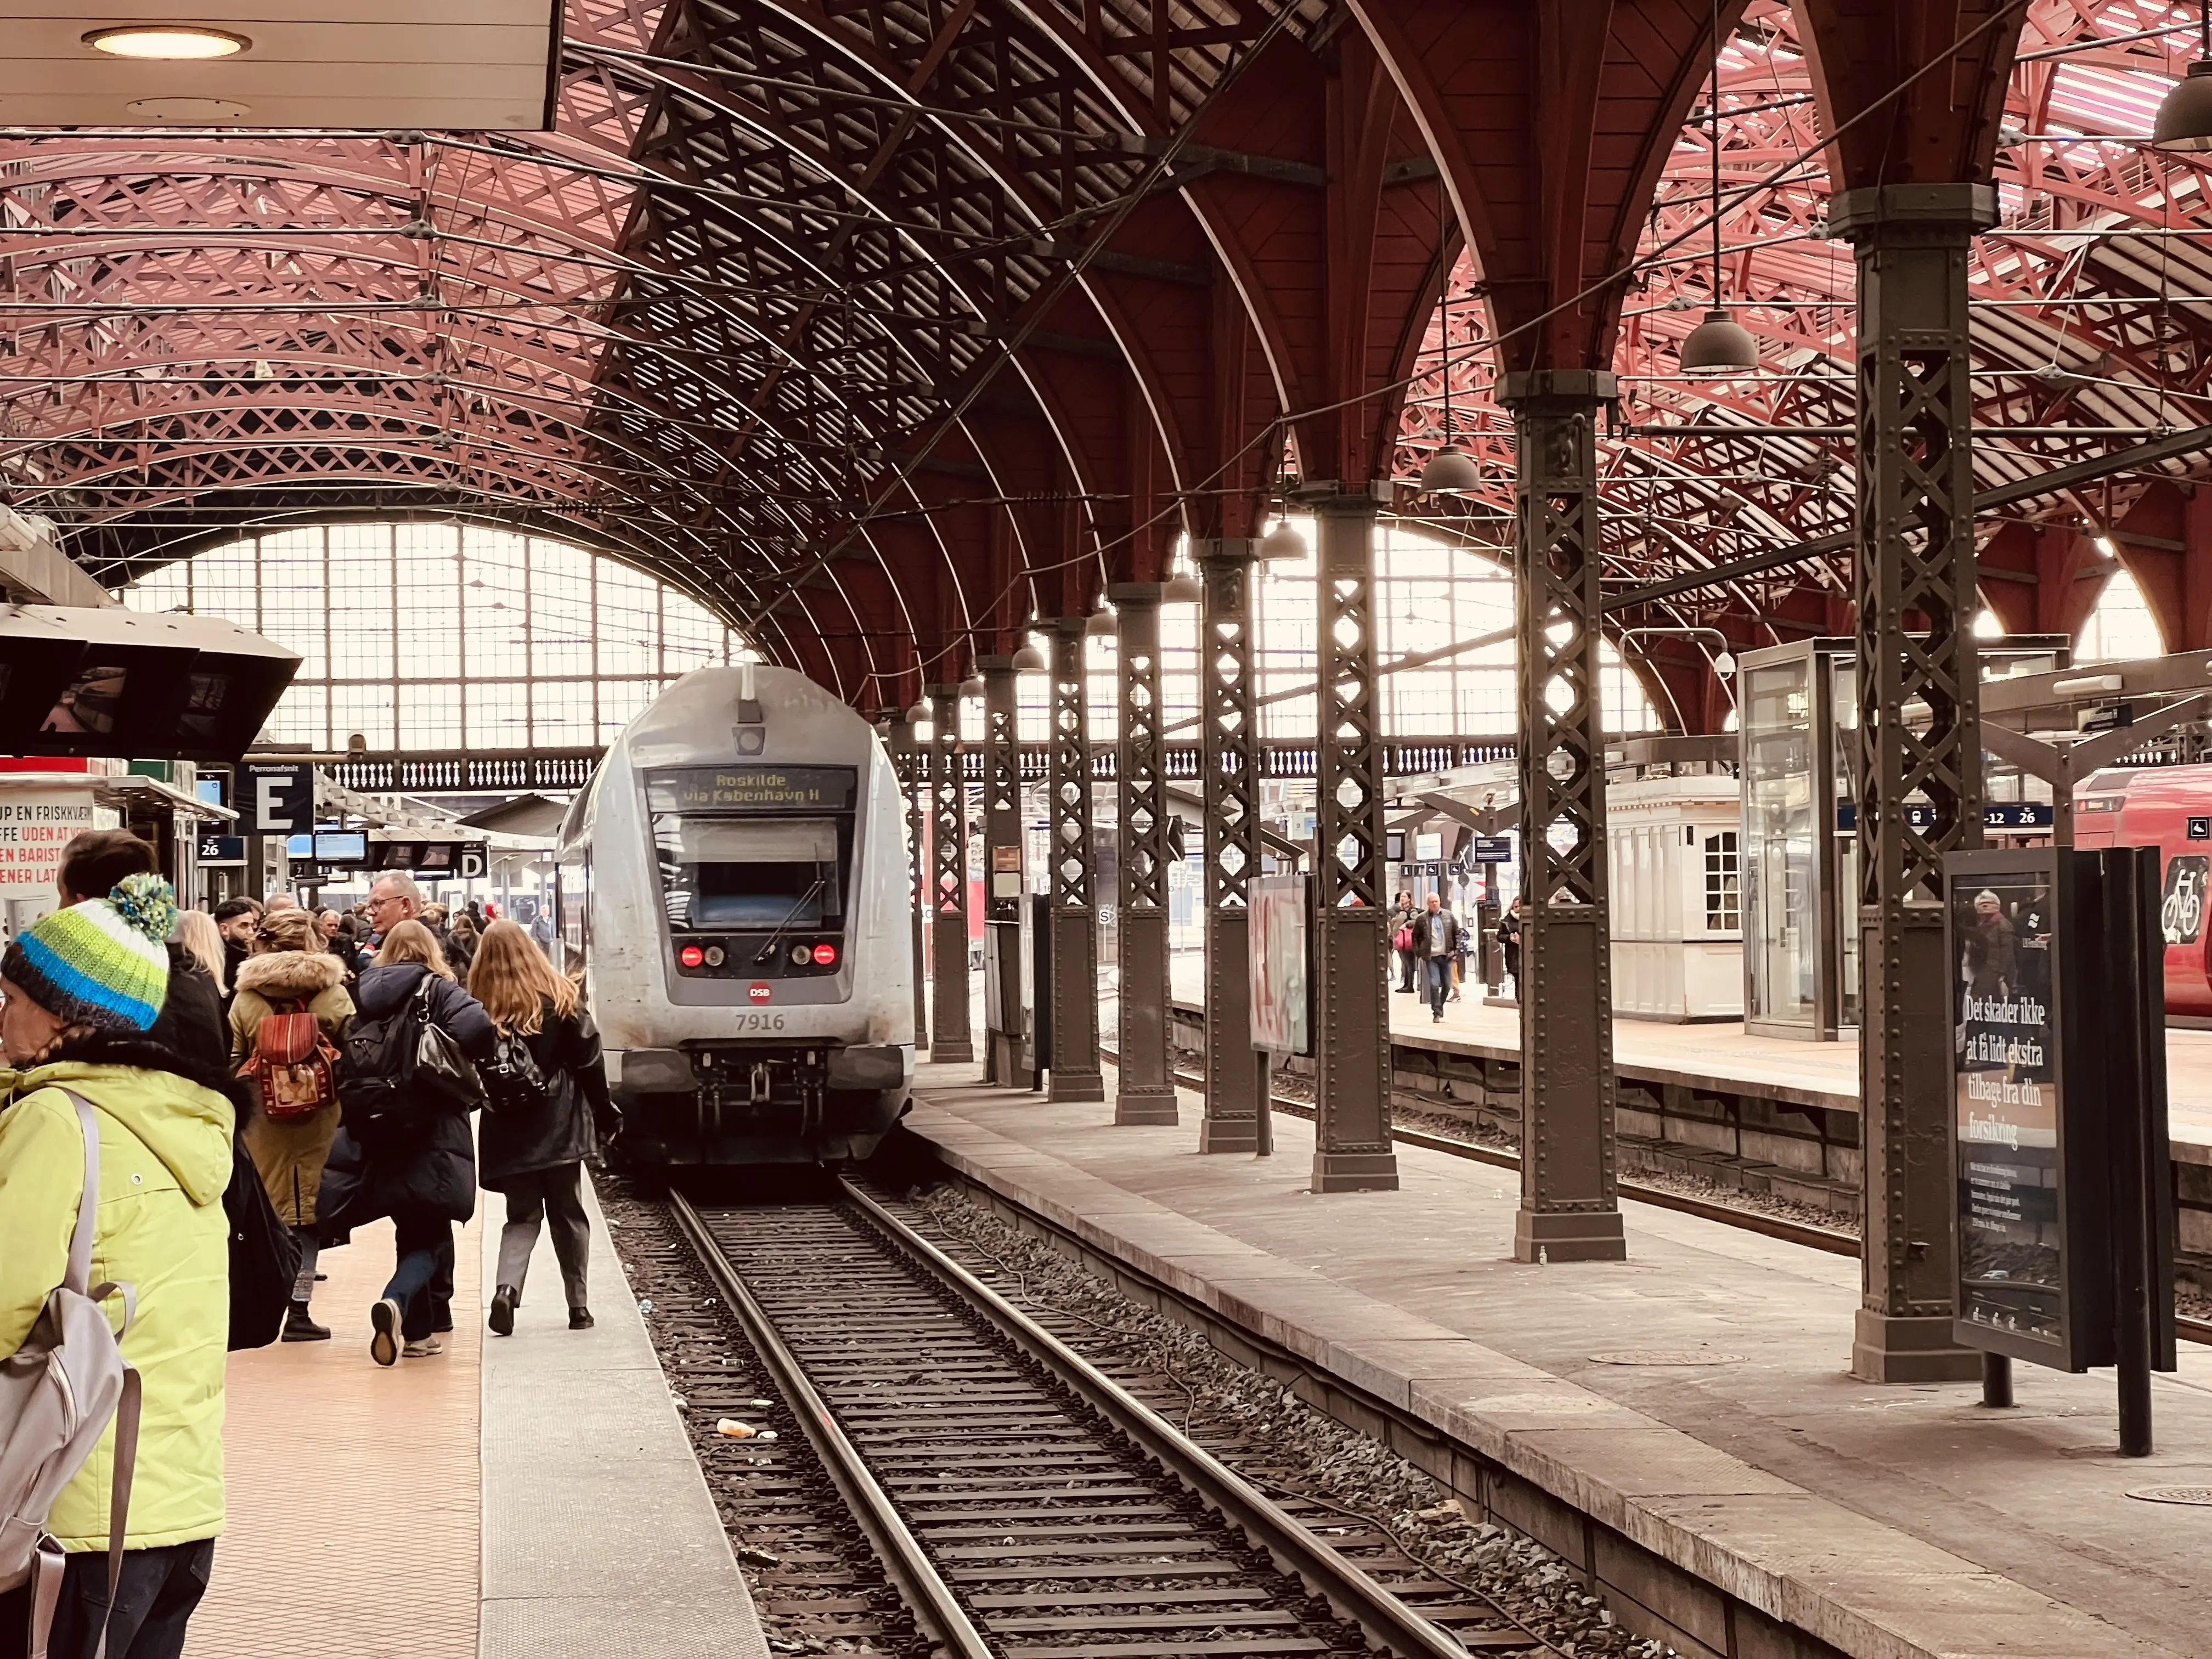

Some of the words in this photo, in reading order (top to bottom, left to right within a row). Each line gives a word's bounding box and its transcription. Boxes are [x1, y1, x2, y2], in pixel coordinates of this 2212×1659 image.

[716, 774, 786, 787] Roskilde
[684, 788, 708, 802] via
[809, 789, 819, 800] H
[257, 776, 294, 829] E
[17, 806, 32, 820] EN
[1983, 812, 2005, 824] -12
[2019, 812, 2035, 823] 26
[21, 827, 53, 841] UDEN
[57, 827, 67, 841] AT
[19, 848, 60, 862] BARIST
[201, 844, 219, 855] 26
[462, 854, 482, 877] D
[36, 868, 57, 883] LAT
[1101, 911, 1109, 922] S
[1966, 995, 1983, 1021] Det
[1984, 995, 2019, 1024] skader
[2021, 996, 2045, 1025] ikke
[736, 1014, 785, 1030] 7916
[1967, 1036, 1978, 1060] at
[1989, 1034, 2006, 1063] lidt
[2008, 1036, 2044, 1066] ekstra
[1968, 1073, 2002, 1108] tilbage
[2003, 1075, 2019, 1104] fra
[2022, 1077, 2042, 1107] din
[1970, 1111, 2018, 1151] forsikring
